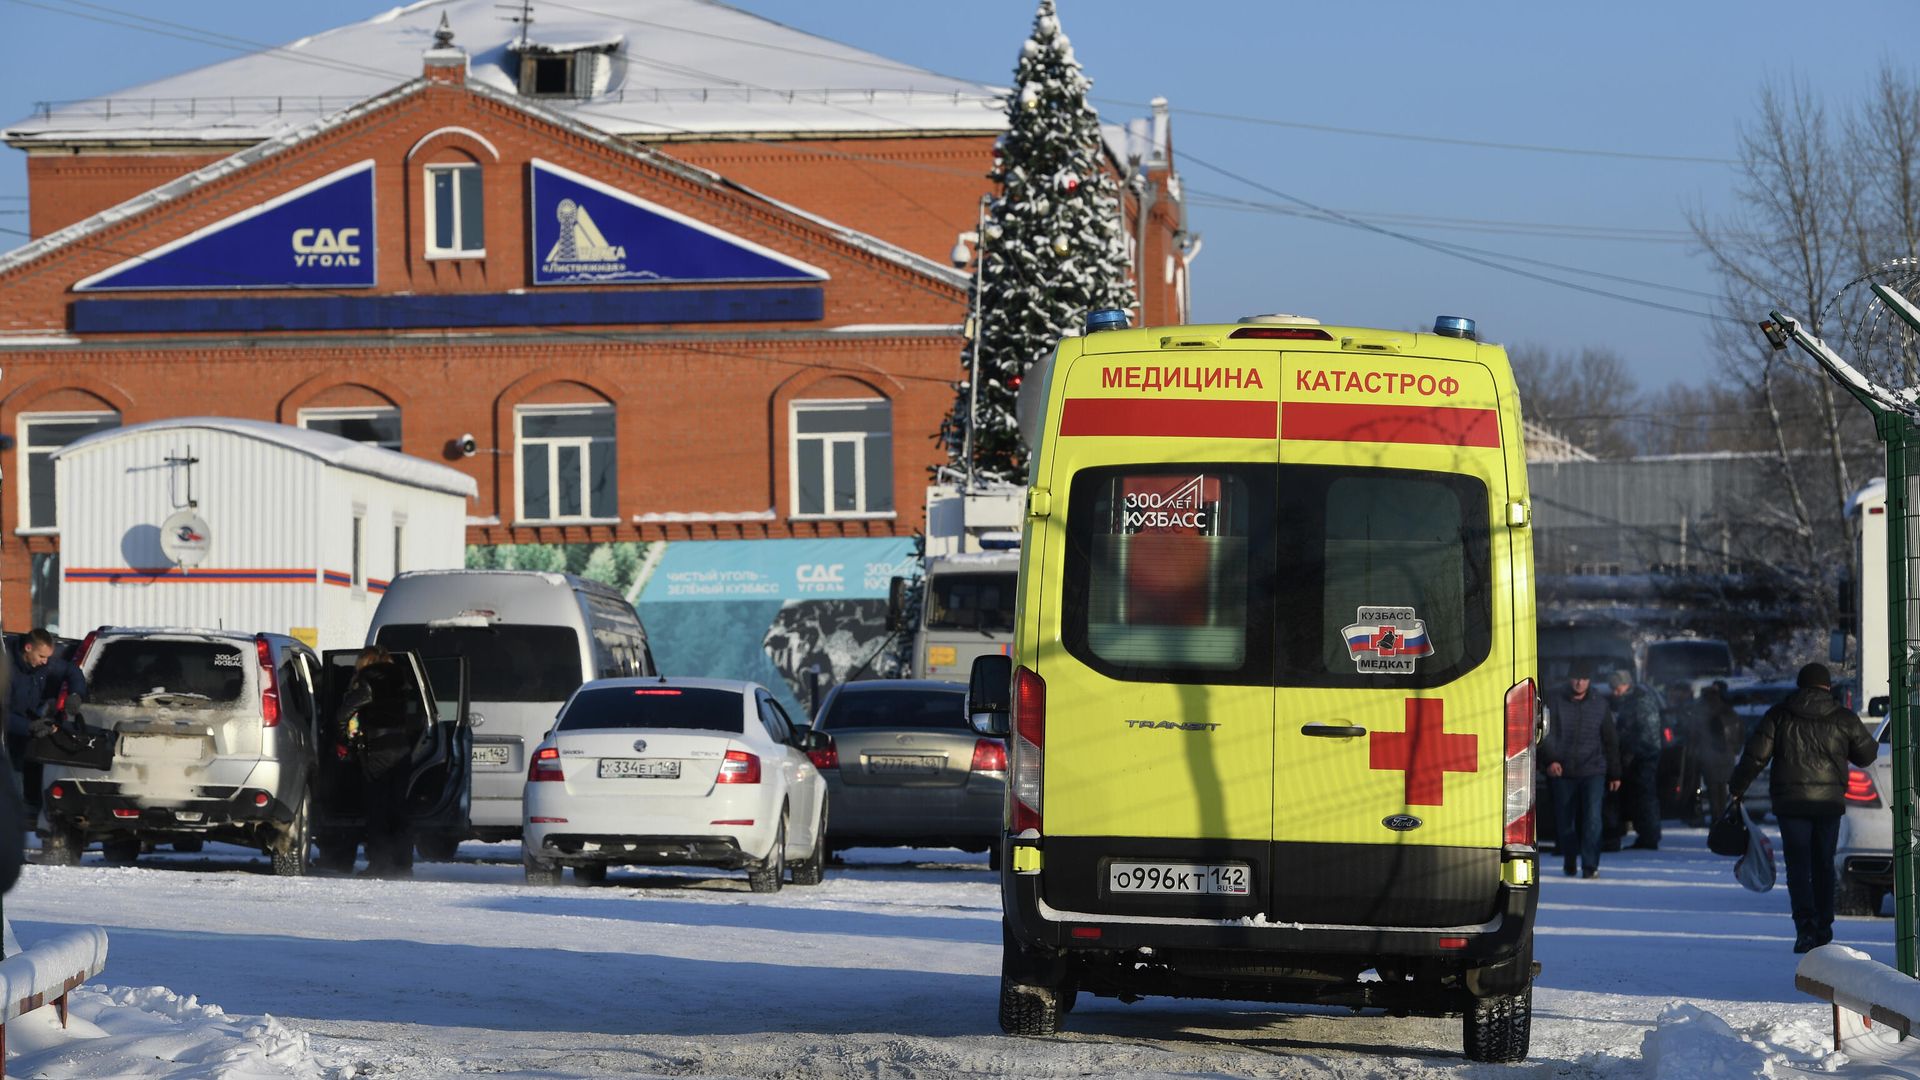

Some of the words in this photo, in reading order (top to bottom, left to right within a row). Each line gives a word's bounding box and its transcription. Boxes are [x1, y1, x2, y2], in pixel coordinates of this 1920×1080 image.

[294, 255, 361, 267] УГОЛЬ
[1102, 367, 1263, 392] МЕДИЦИНА
[1296, 370, 1459, 396] КАТАСТРОФ
[1127, 493, 1161, 508] 300
[1167, 500, 1191, 509] ЛЕТ
[1125, 512, 1206, 527] КУЗБАСС
[720, 571, 759, 581] УГОЛЬ
[724, 583, 779, 593] КУЗБАСС
[798, 583, 845, 592] УГОЛЬ
[1361, 612, 1411, 620] КУЗБАСС
[1360, 660, 1412, 669] МЕДКАТ
[1125, 720, 1221, 731] TRANSIT
[1391, 817, 1414, 827] Ford
[1211, 868, 1243, 885] 142
